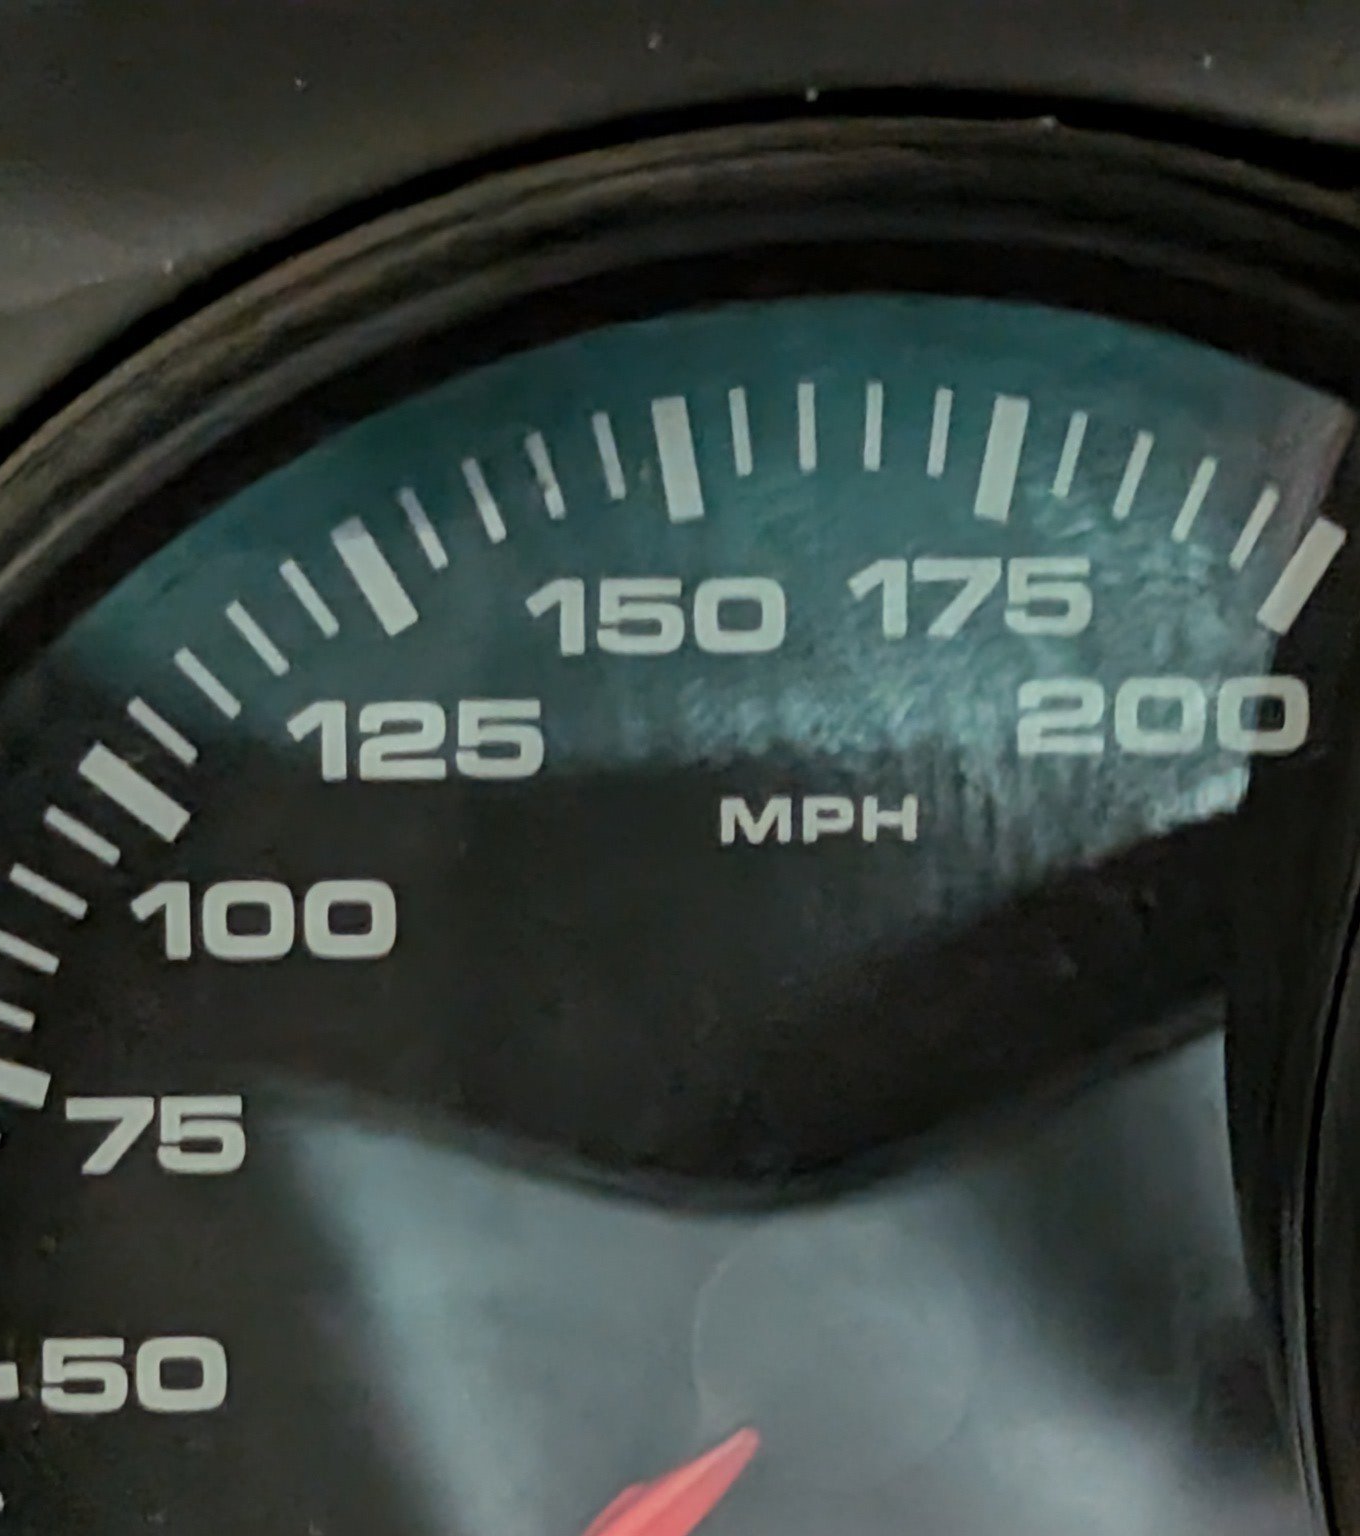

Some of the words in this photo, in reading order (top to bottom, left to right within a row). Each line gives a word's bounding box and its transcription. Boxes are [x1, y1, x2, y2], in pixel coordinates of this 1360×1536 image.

[525, 576, 787, 656] 150
[848, 555, 1093, 640] 175
[286, 699, 545, 781] 125
[1015, 674, 1309, 758] 200
[720, 793, 919, 844] MPH
[130, 879, 397, 960] 100
[65, 1095, 246, 1175] 75
[41, 1336, 228, 1414] 50
